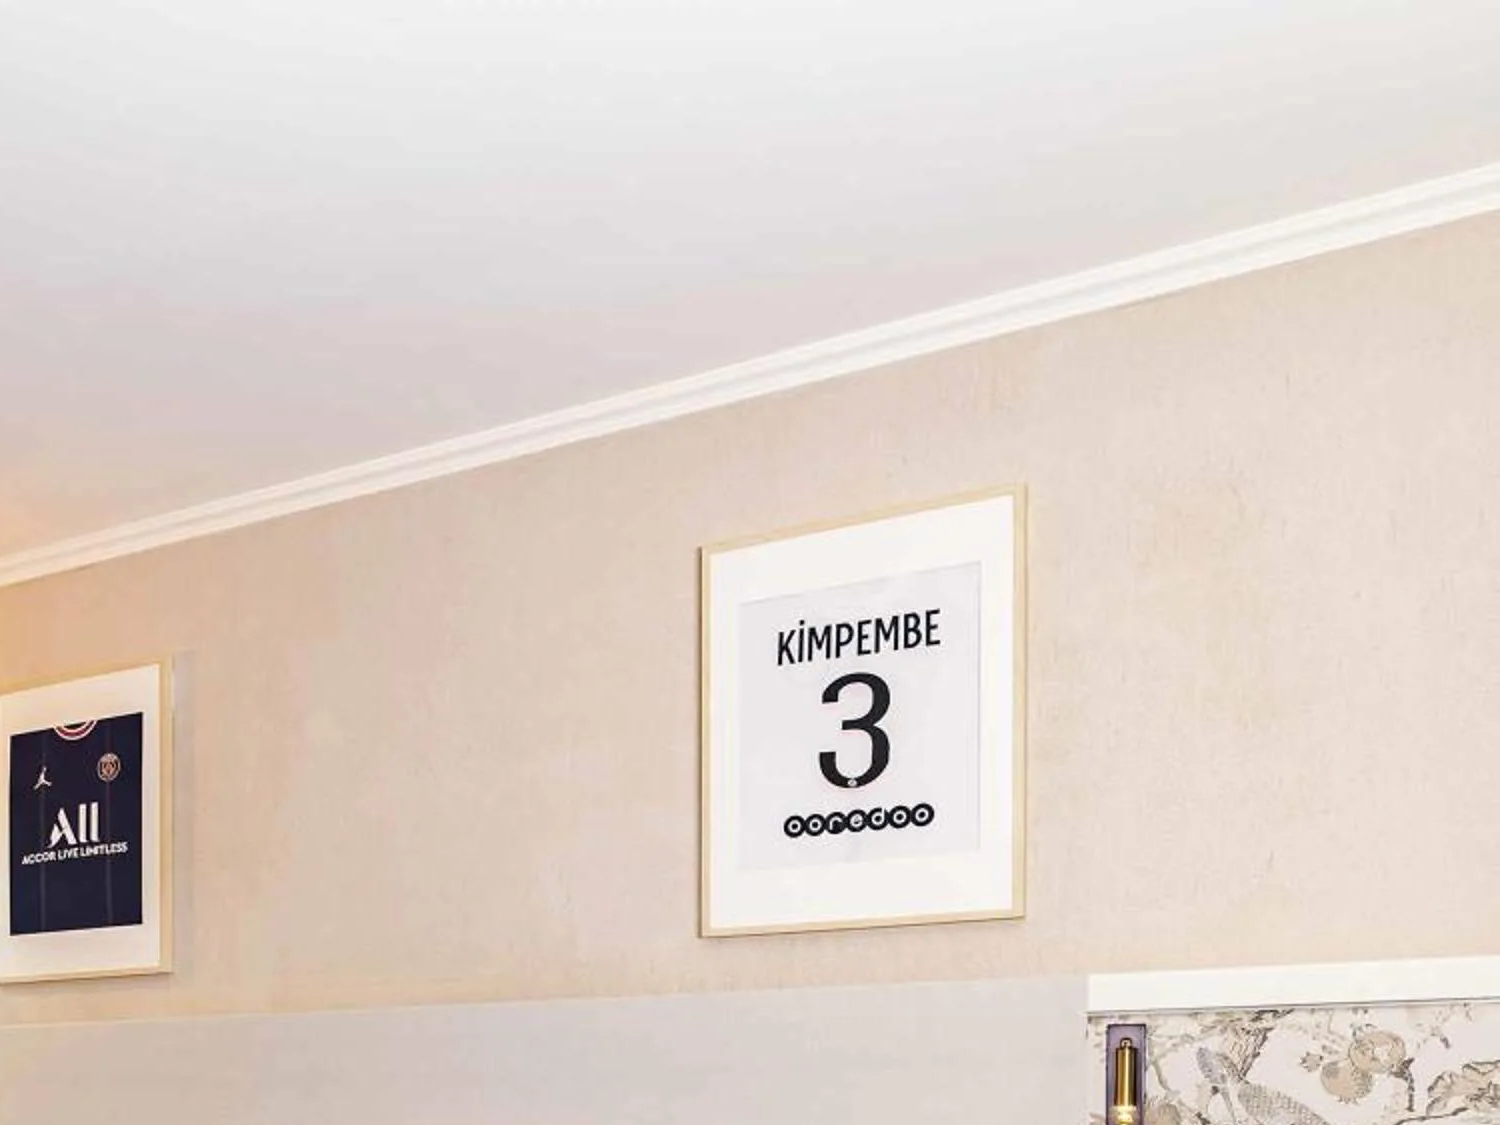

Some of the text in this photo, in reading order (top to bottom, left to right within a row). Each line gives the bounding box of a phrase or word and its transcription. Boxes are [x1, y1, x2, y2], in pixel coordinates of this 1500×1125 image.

[818, 671, 891, 789] 3
[783, 802, 935, 838] ooredoo
[21, 841, 128, 865] ACCOR LIVE LIMITLESS
